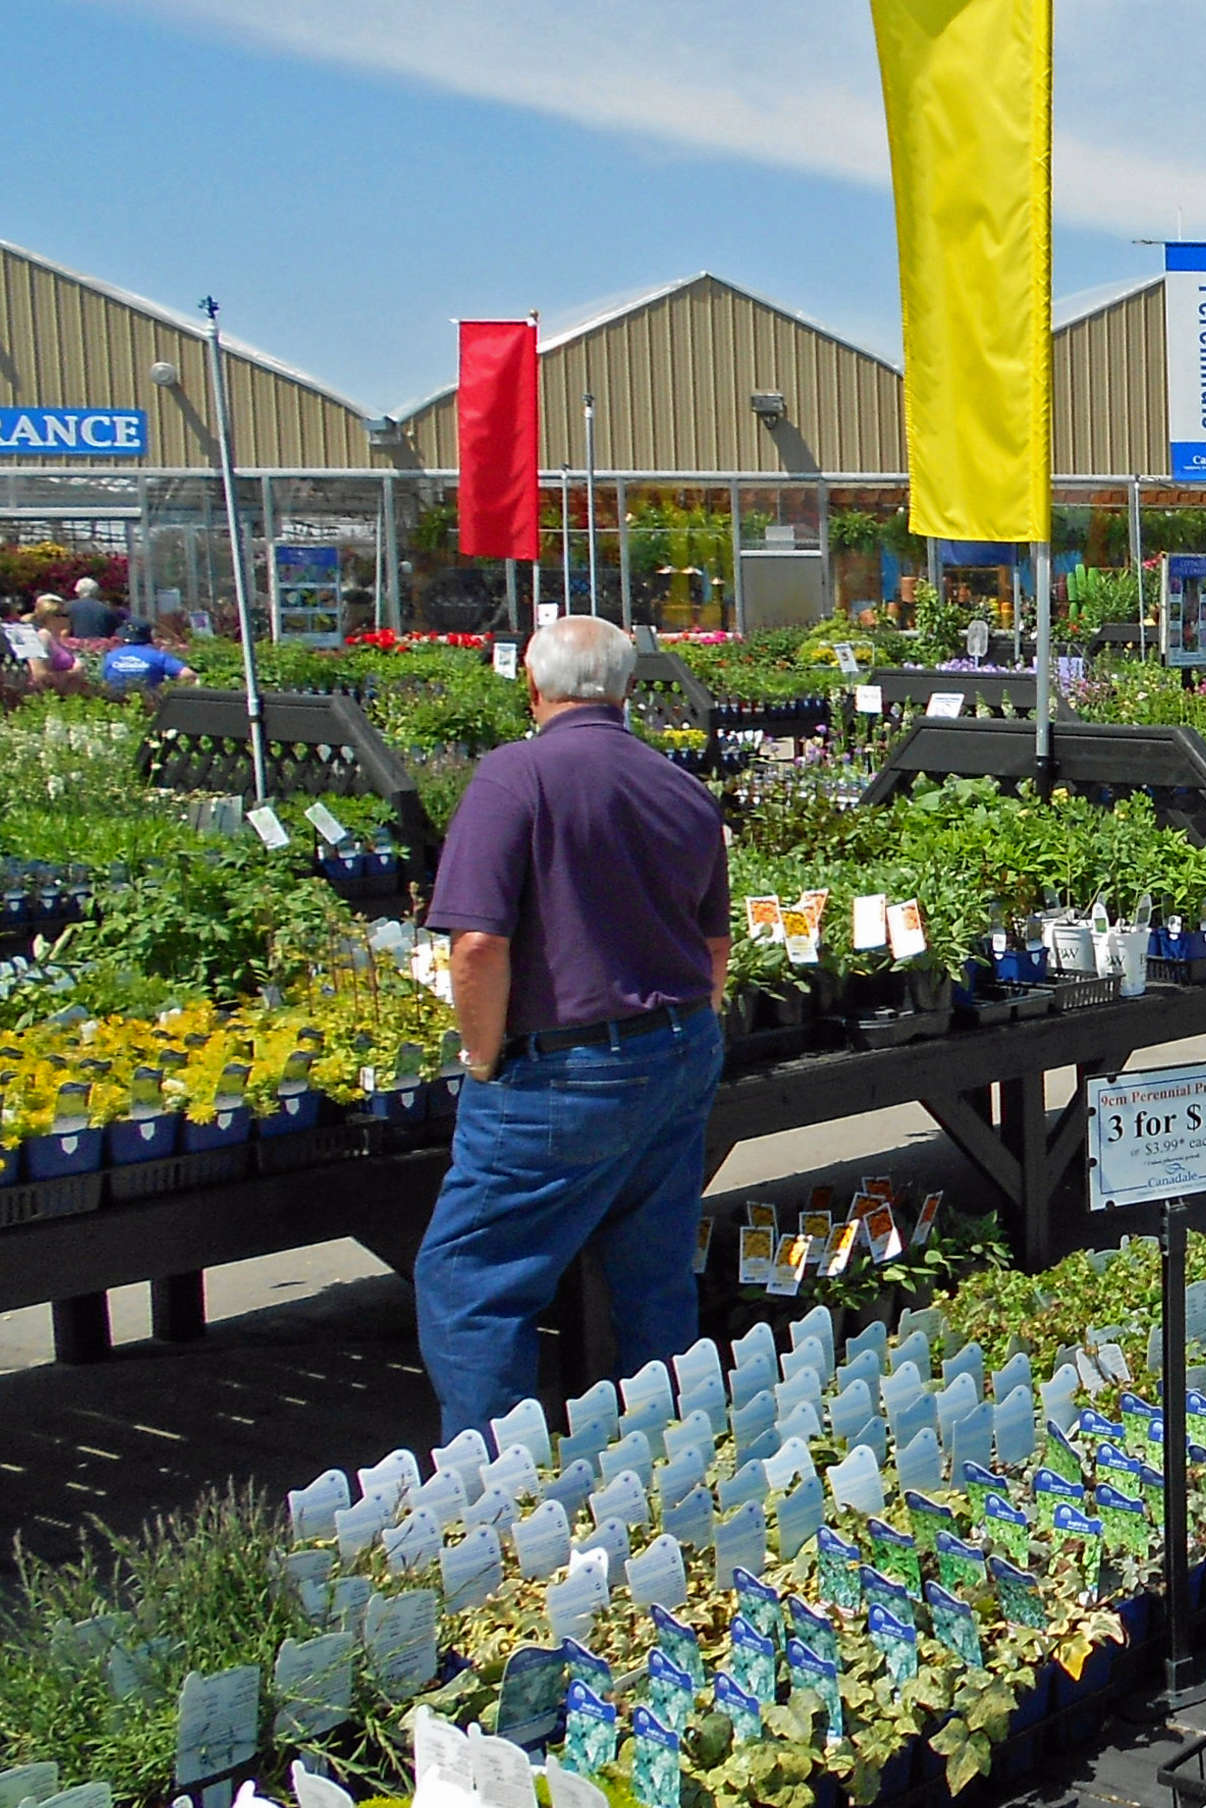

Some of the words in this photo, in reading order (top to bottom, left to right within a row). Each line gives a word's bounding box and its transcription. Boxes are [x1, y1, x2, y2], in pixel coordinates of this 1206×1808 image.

[1101, 1095, 1127, 1107] 9cm
[1131, 1086, 1191, 1103] Perennial
[1107, 1115, 1124, 1143] 3
[1134, 1111, 1177, 1138] for
[1147, 1171, 1199, 1188] Canadale
